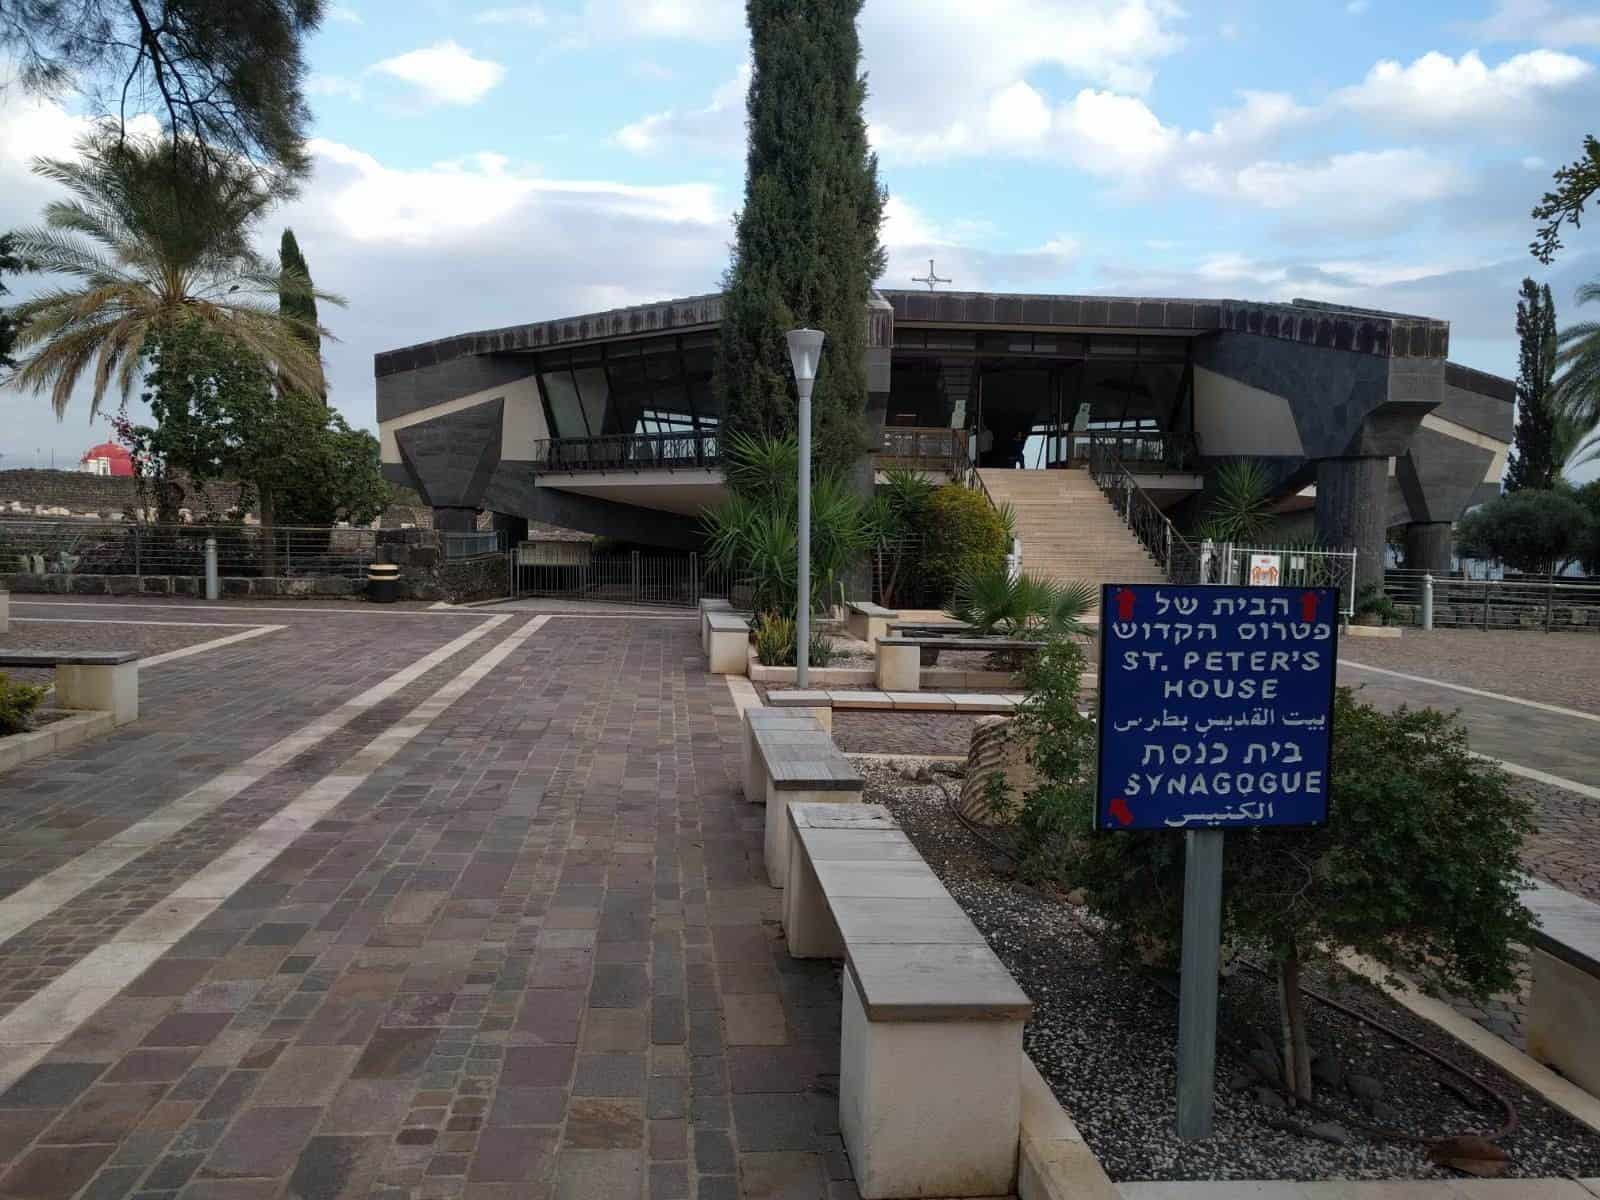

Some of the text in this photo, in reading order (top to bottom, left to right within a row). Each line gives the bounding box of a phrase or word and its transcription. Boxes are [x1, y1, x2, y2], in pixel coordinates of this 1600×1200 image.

[1155, 591, 1289, 616] הבית של
[1112, 622, 1331, 645] פטרוס הקדוש
[1122, 651, 1168, 672] ST.
[1164, 678, 1278, 699] HOUSE
[1141, 741, 1303, 766] בית כנסת
[1124, 771, 1321, 797] SYNAGOGUE
